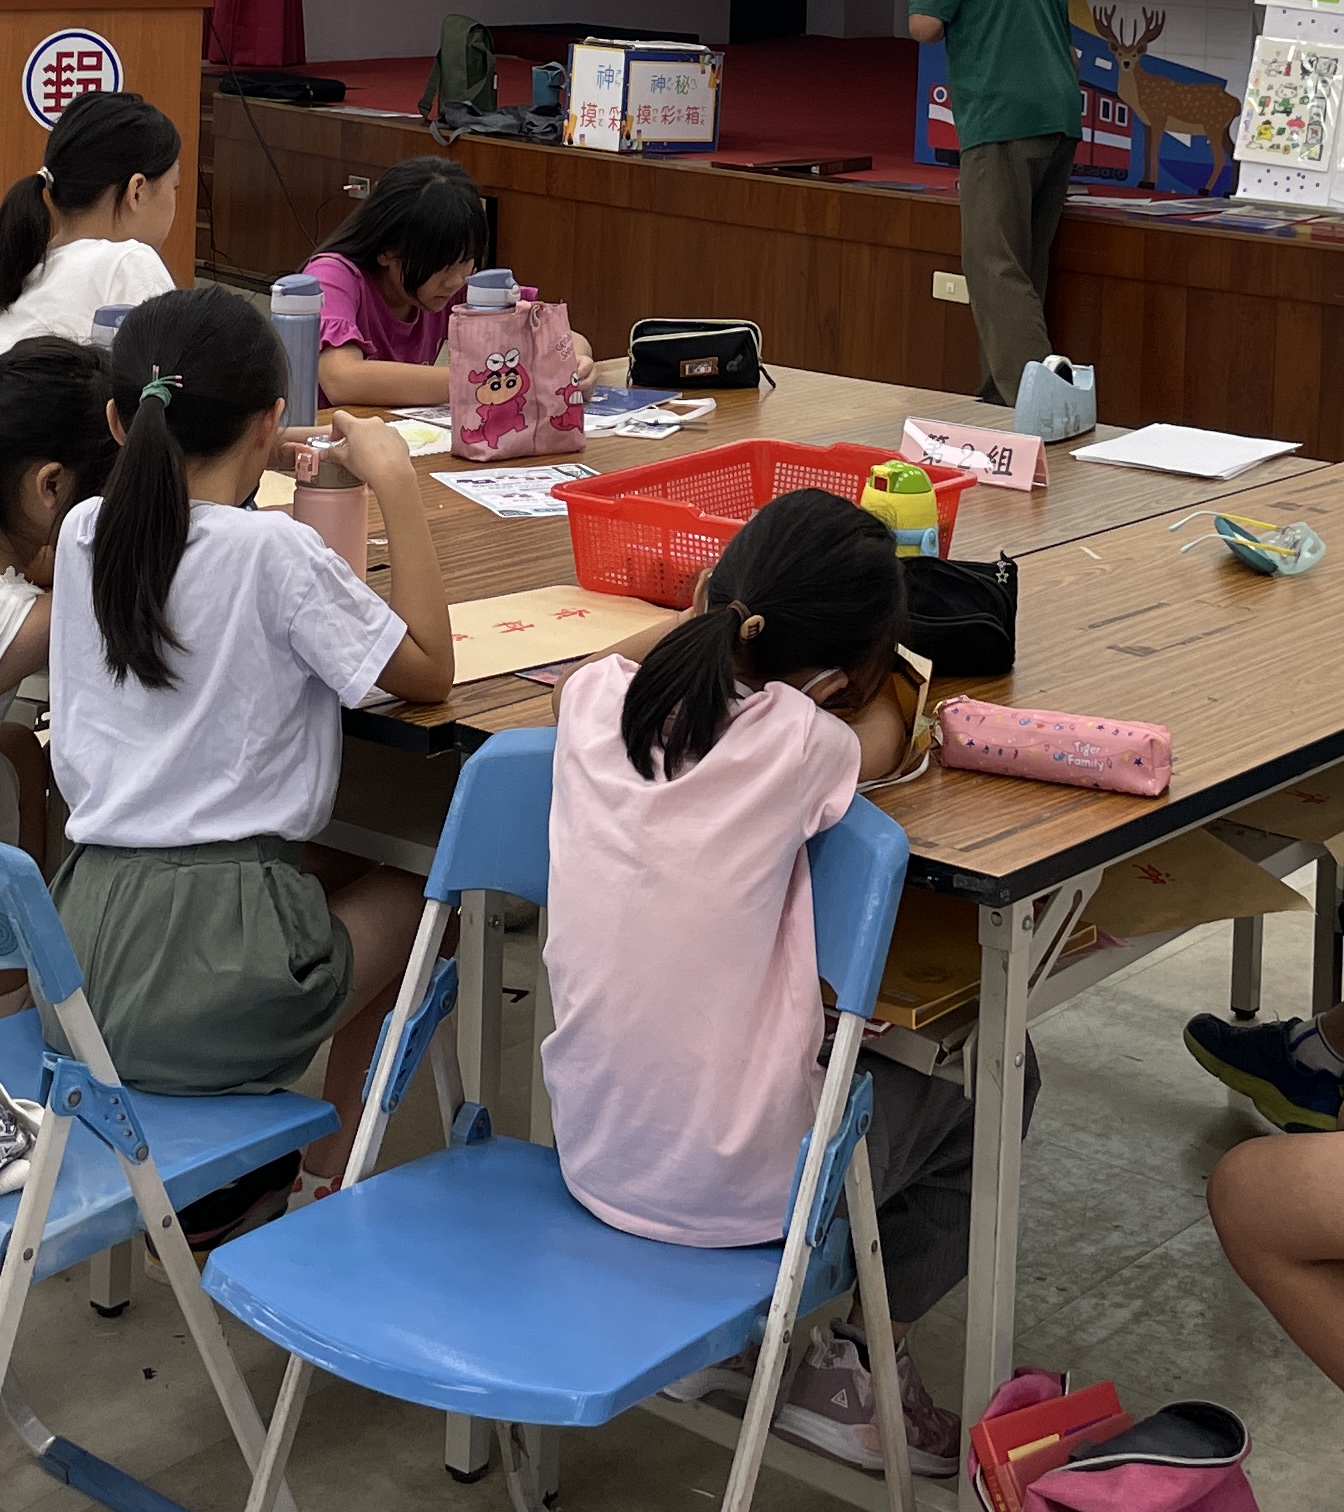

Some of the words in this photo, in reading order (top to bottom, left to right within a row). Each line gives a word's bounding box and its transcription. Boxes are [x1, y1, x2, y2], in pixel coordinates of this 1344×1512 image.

[919, 433, 1014, 477] 第2組
[1073, 741, 1102, 757] Tiger
[1067, 754, 1106, 772] Family
